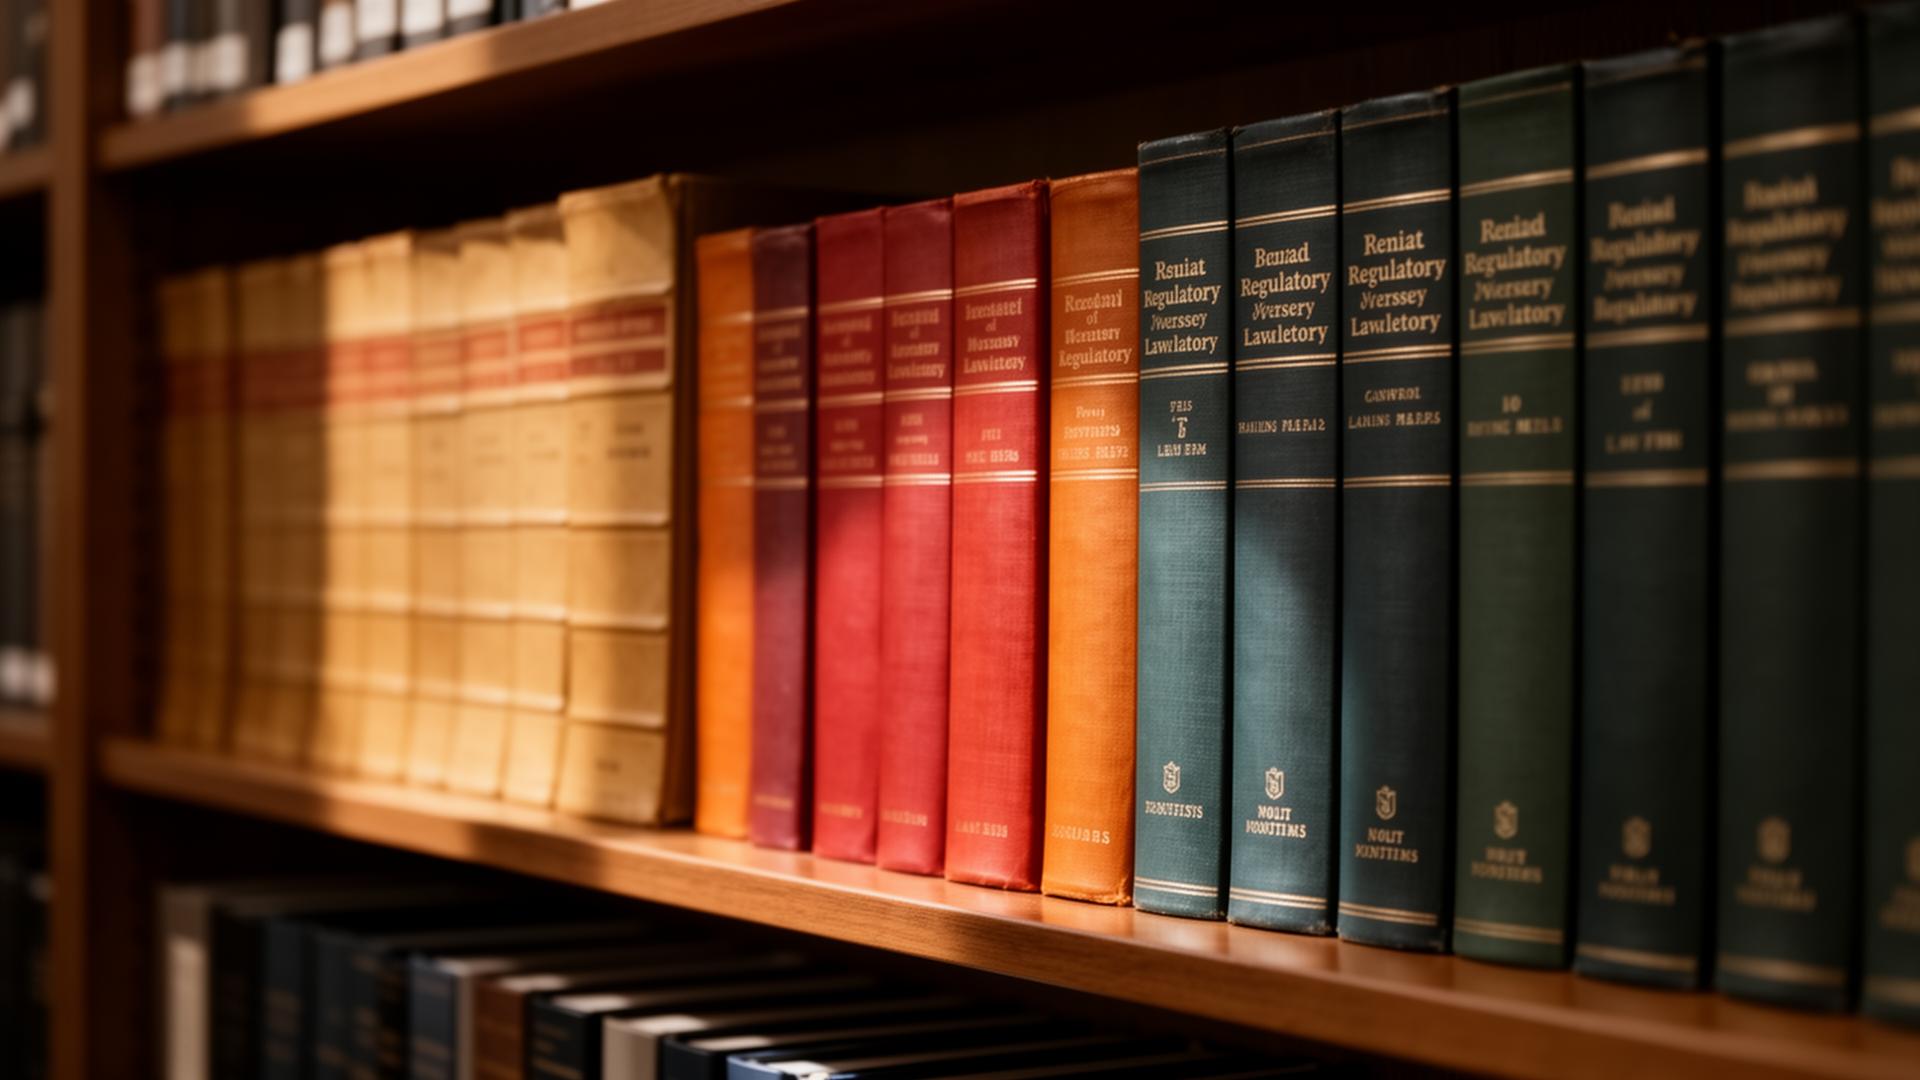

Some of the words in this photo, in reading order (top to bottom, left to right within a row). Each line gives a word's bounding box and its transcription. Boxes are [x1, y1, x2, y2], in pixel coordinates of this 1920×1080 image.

[1347, 257, 1447, 288] Regulatory
[1463, 245, 1567, 278] Regulatory
[1143, 284, 1223, 311] Regulatory
[1240, 271, 1332, 299] Regulatory
